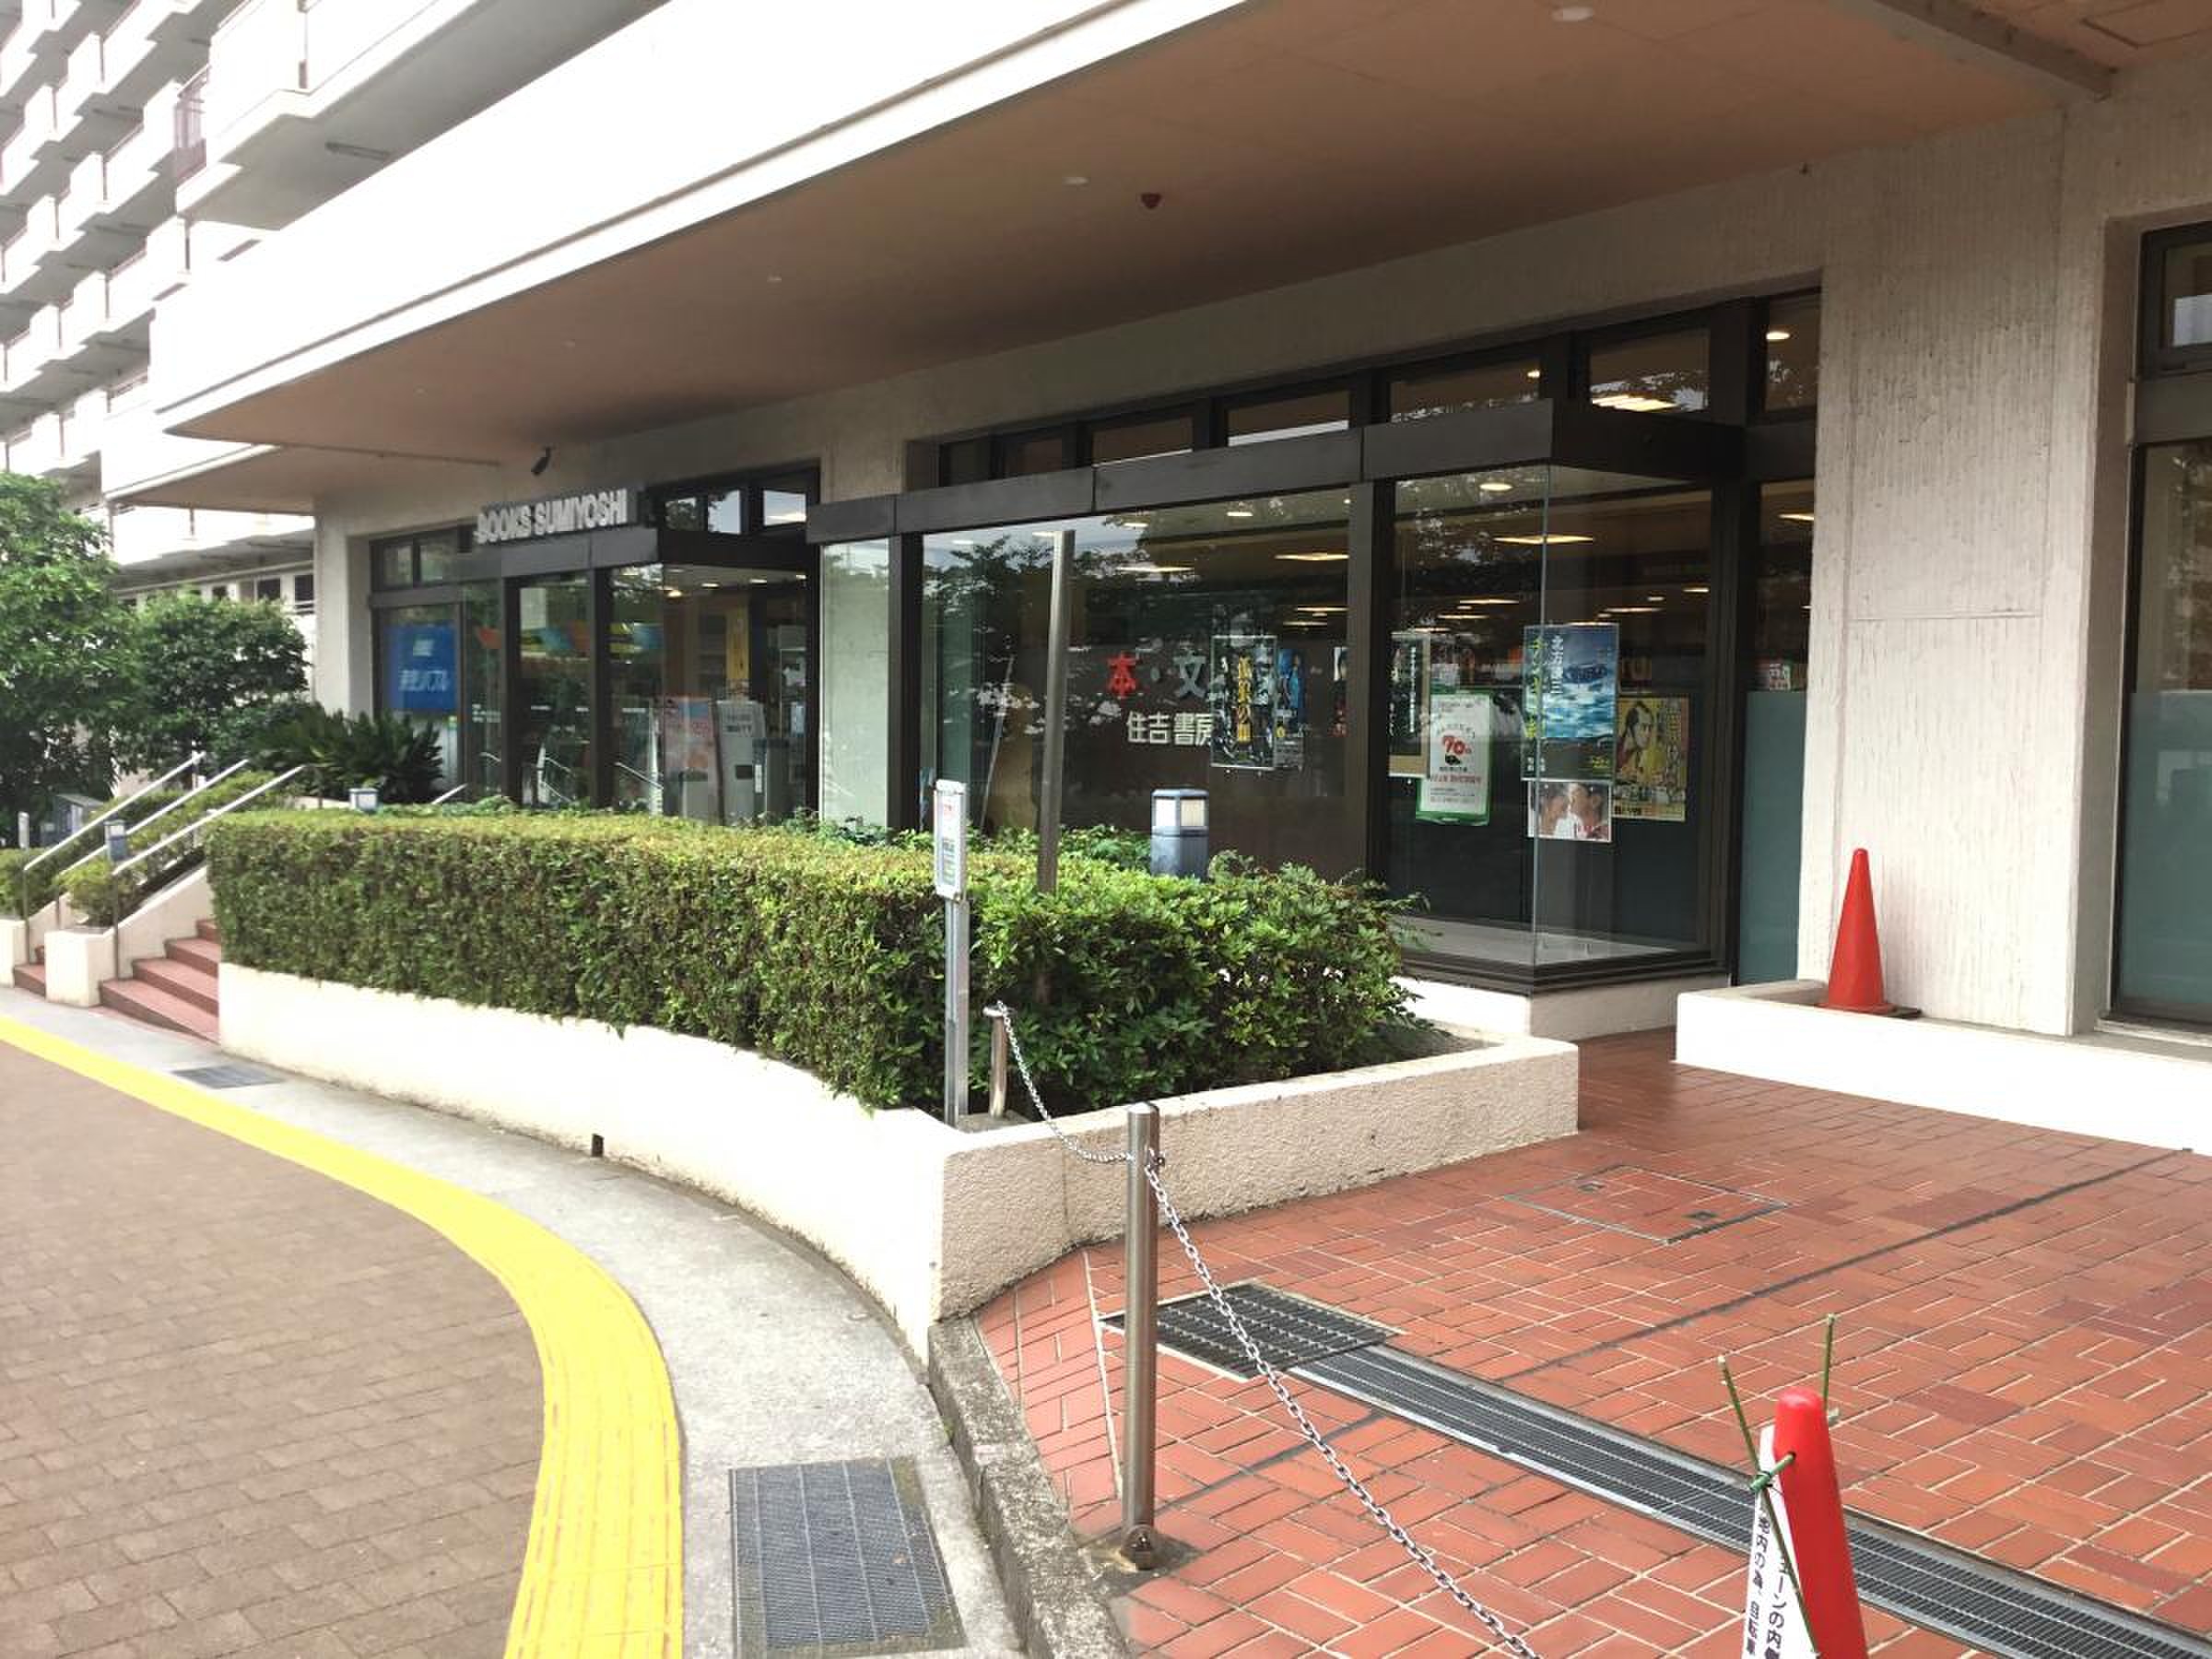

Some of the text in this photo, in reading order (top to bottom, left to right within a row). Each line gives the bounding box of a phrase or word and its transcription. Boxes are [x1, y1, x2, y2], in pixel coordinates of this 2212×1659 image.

[473, 488, 627, 544] BOOKS SUMIYOSHI
[1126, 711, 1214, 746] 住吉書房
